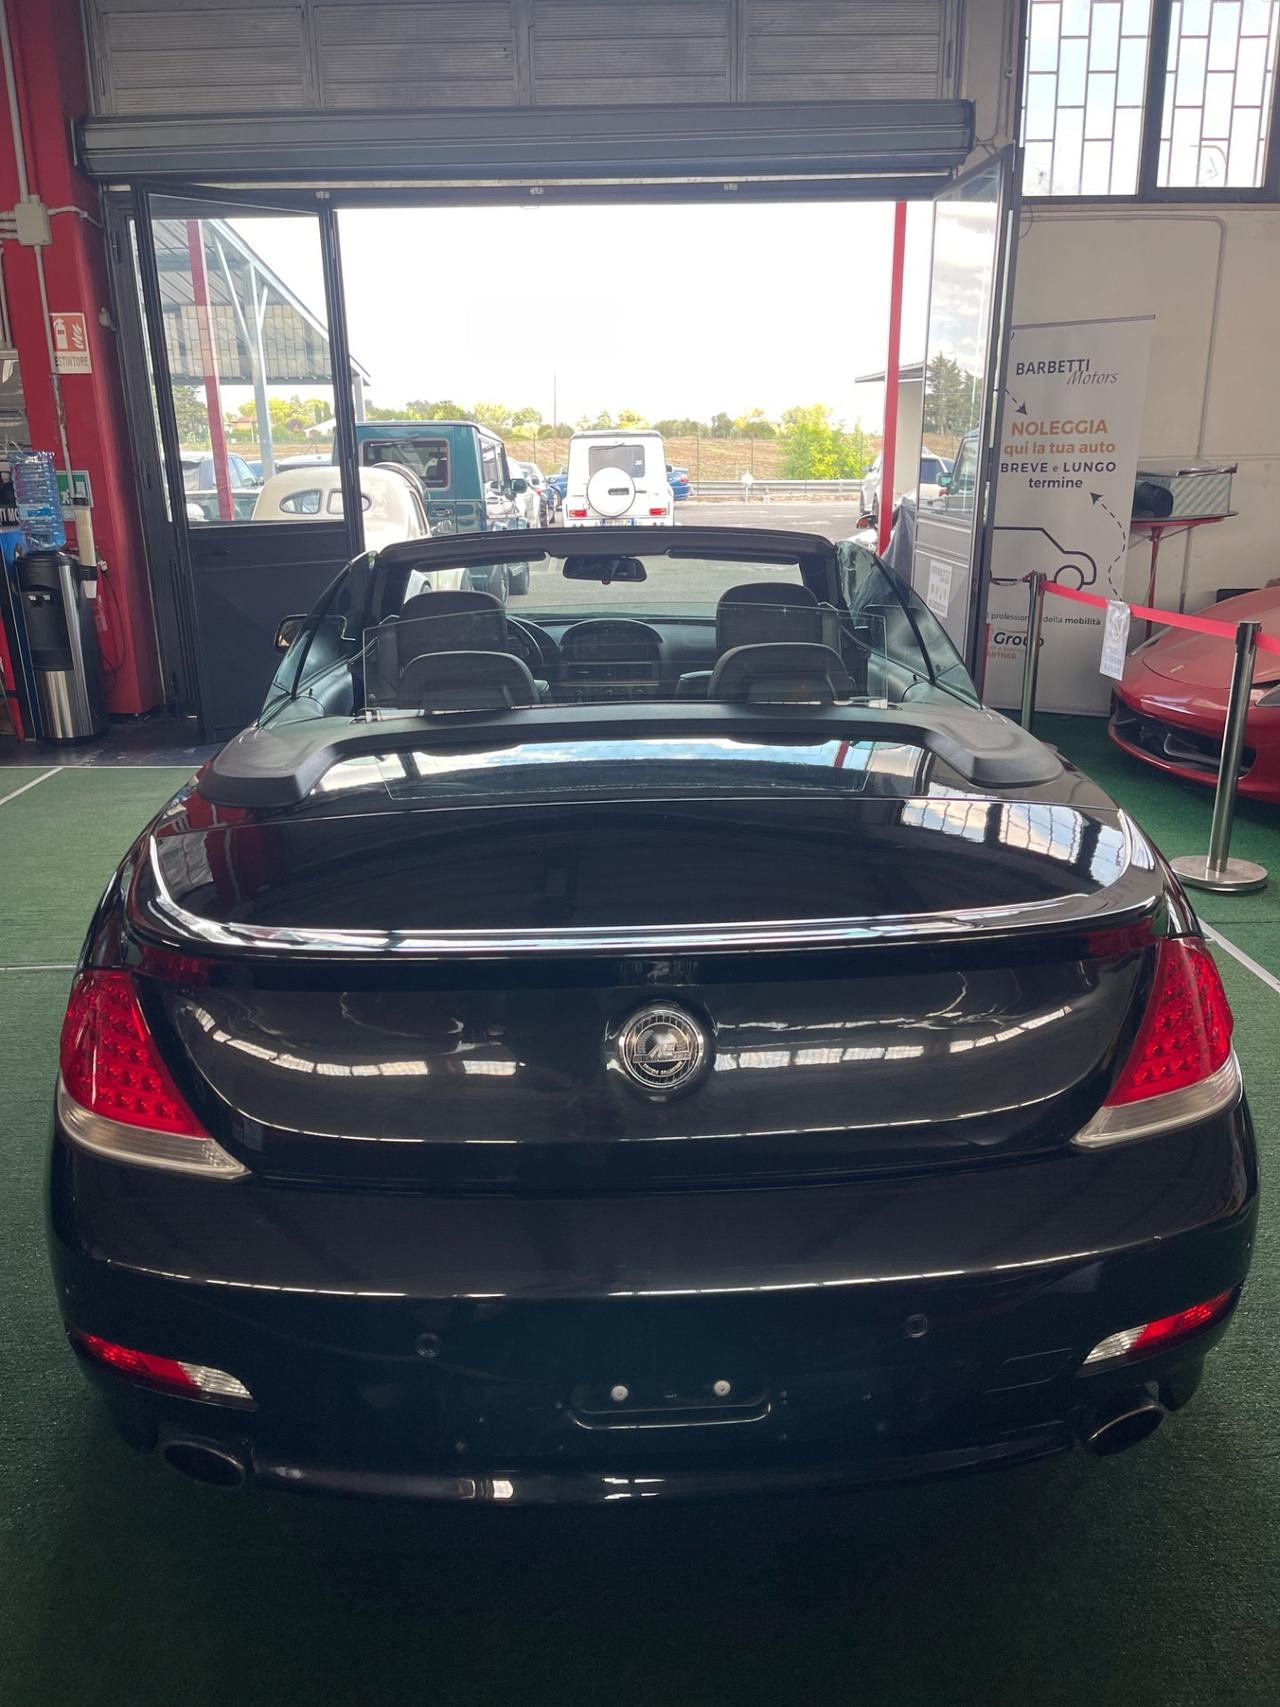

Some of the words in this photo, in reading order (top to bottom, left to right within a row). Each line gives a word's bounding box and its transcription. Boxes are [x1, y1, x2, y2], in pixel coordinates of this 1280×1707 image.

[1016, 359, 1090, 376] BARBETTI
[1067, 370, 1119, 385] Motors
[1011, 419, 1109, 436] NOLEGGIA
[1004, 441, 1029, 457] qui
[1032, 441, 1046, 455] la
[1049, 441, 1075, 454] tua
[1079, 440, 1116, 454] auto
[1000, 462, 1049, 473] BREVE
[1052, 465, 1059, 473] e
[1063, 461, 1117, 473] LUNGO
[1028, 477, 1083, 488] termine
[1043, 615, 1063, 624] della
[1064, 616, 1101, 626] mobilità
